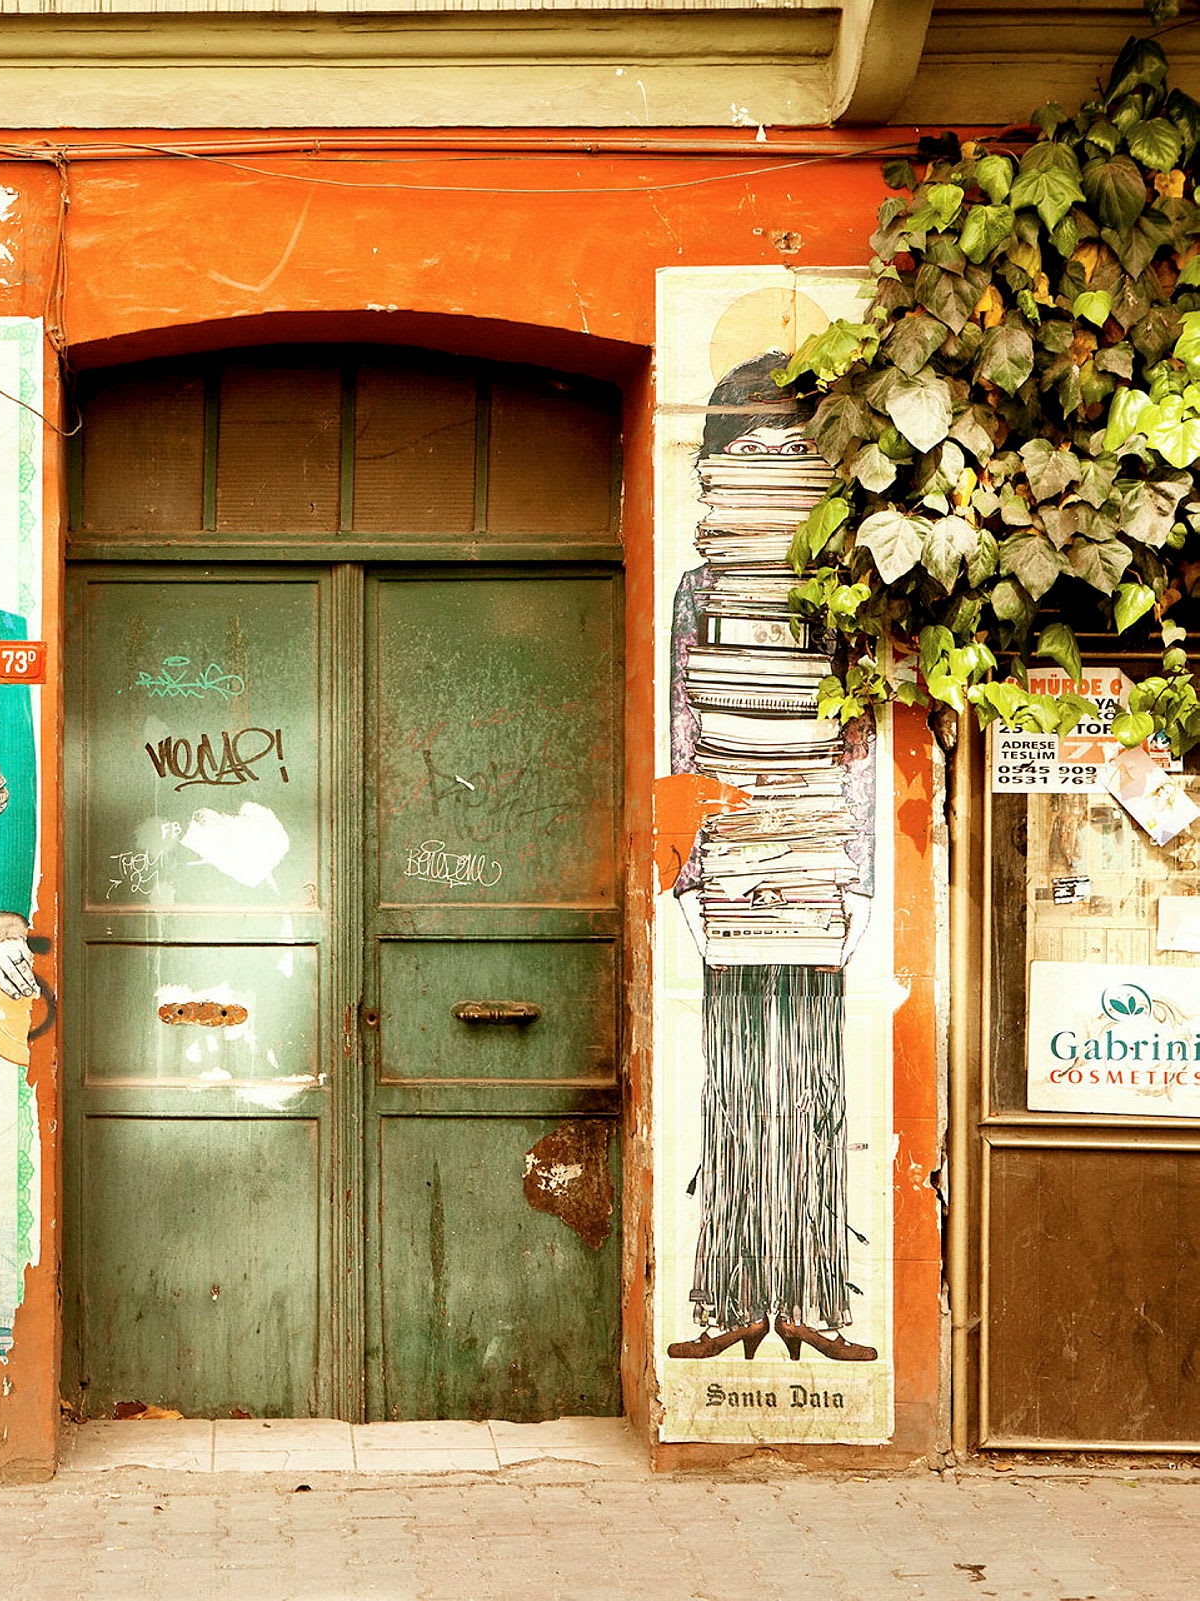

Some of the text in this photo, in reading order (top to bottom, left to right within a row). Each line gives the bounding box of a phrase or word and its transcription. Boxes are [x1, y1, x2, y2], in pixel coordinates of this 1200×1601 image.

[1007, 674, 1102, 696] MÜRDE
[1001, 741, 1056, 750] ADRESE
[998, 765, 1097, 775] 0545 909
[998, 775, 1097, 785] 0531 763
[1050, 1029, 1200, 1061] Gabrini
[706, 1383, 845, 1409] Santa Data
